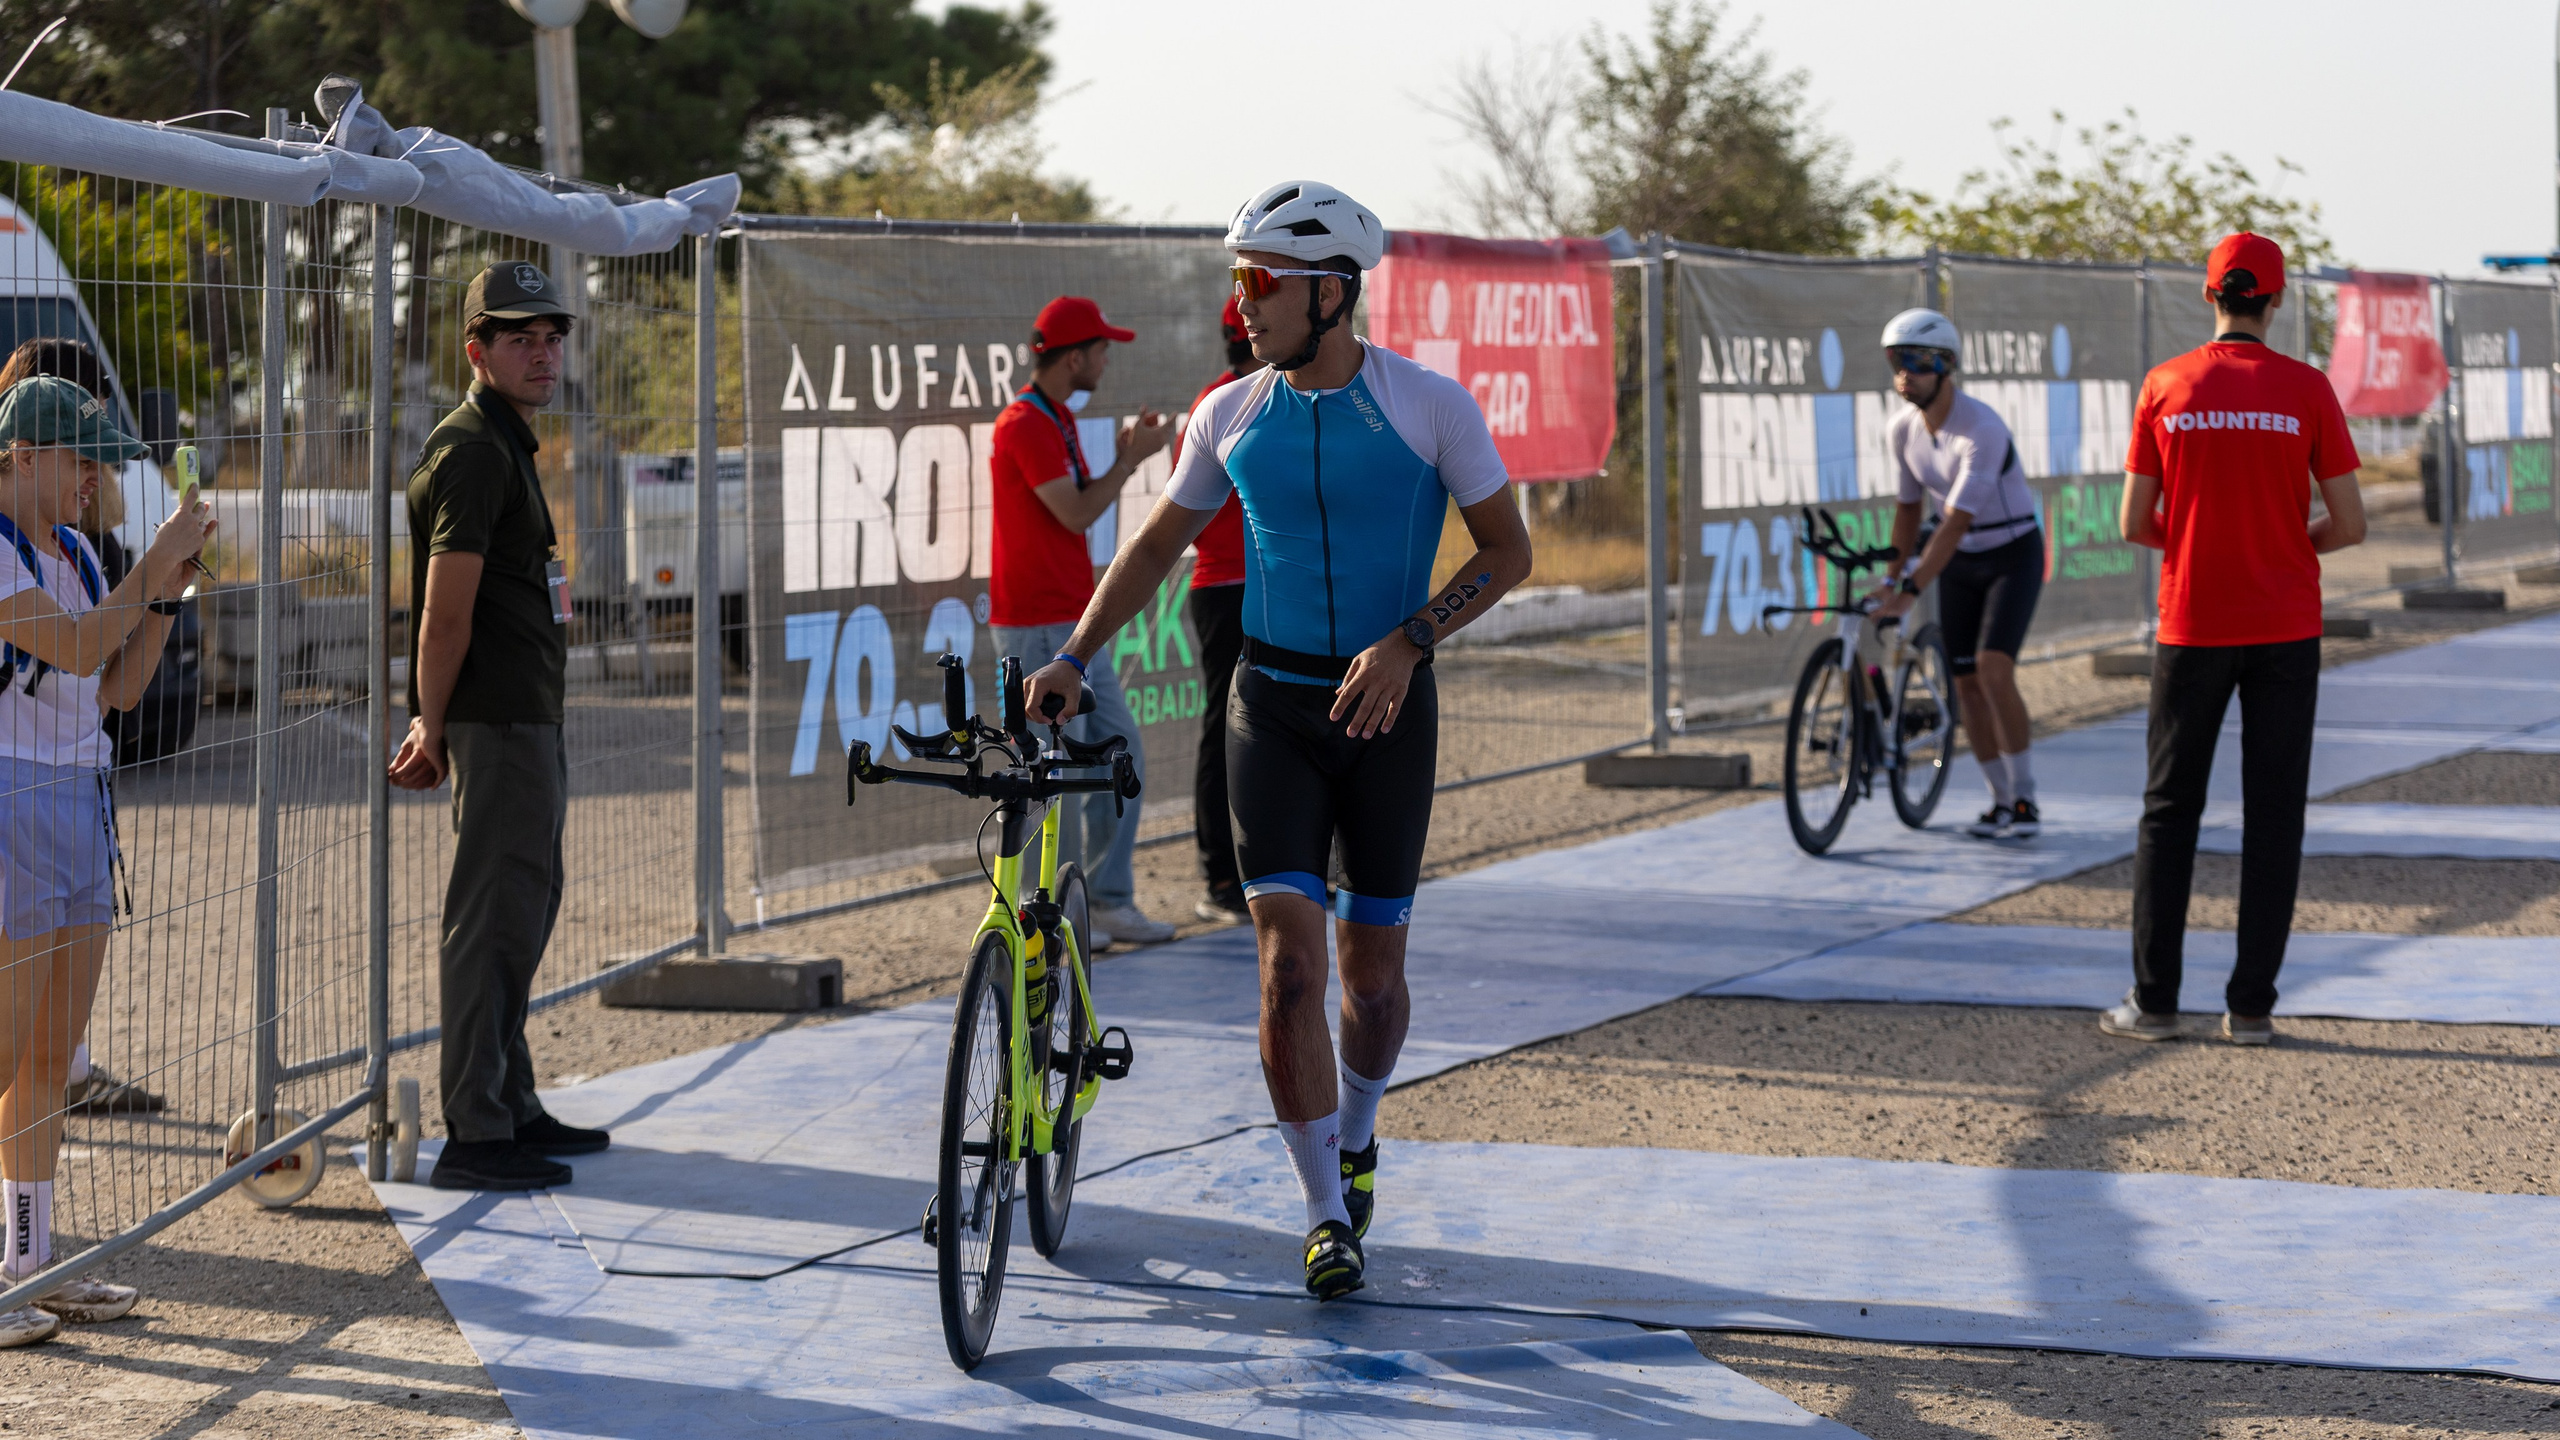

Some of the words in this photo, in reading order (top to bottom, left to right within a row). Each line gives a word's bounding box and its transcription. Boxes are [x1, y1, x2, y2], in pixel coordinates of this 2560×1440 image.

[1314, 199, 1338, 208] PMT
[1349, 389, 1385, 433] sailfish
[2162, 410, 2301, 437] VOLUNTEER
[1429, 583, 1481, 627] 404
